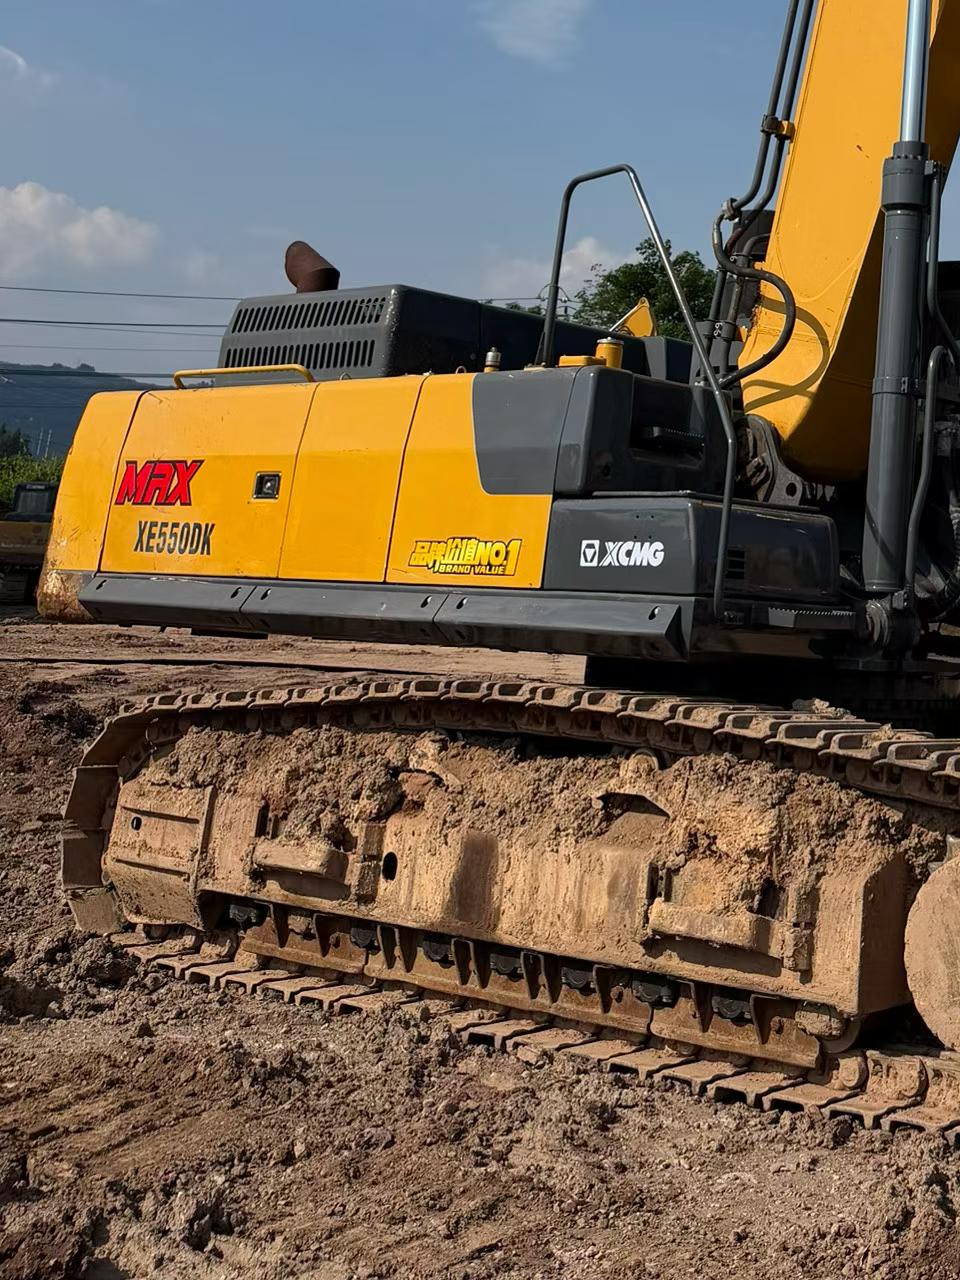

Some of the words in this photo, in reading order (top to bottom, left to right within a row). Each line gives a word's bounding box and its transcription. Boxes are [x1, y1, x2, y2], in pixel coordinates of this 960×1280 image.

[115, 460, 204, 506] MAX
[134, 521, 215, 555] XE550DK
[599, 540, 665, 568] XCMG
[438, 565, 471, 573] BRAND
[474, 566, 505, 575] VALUE
